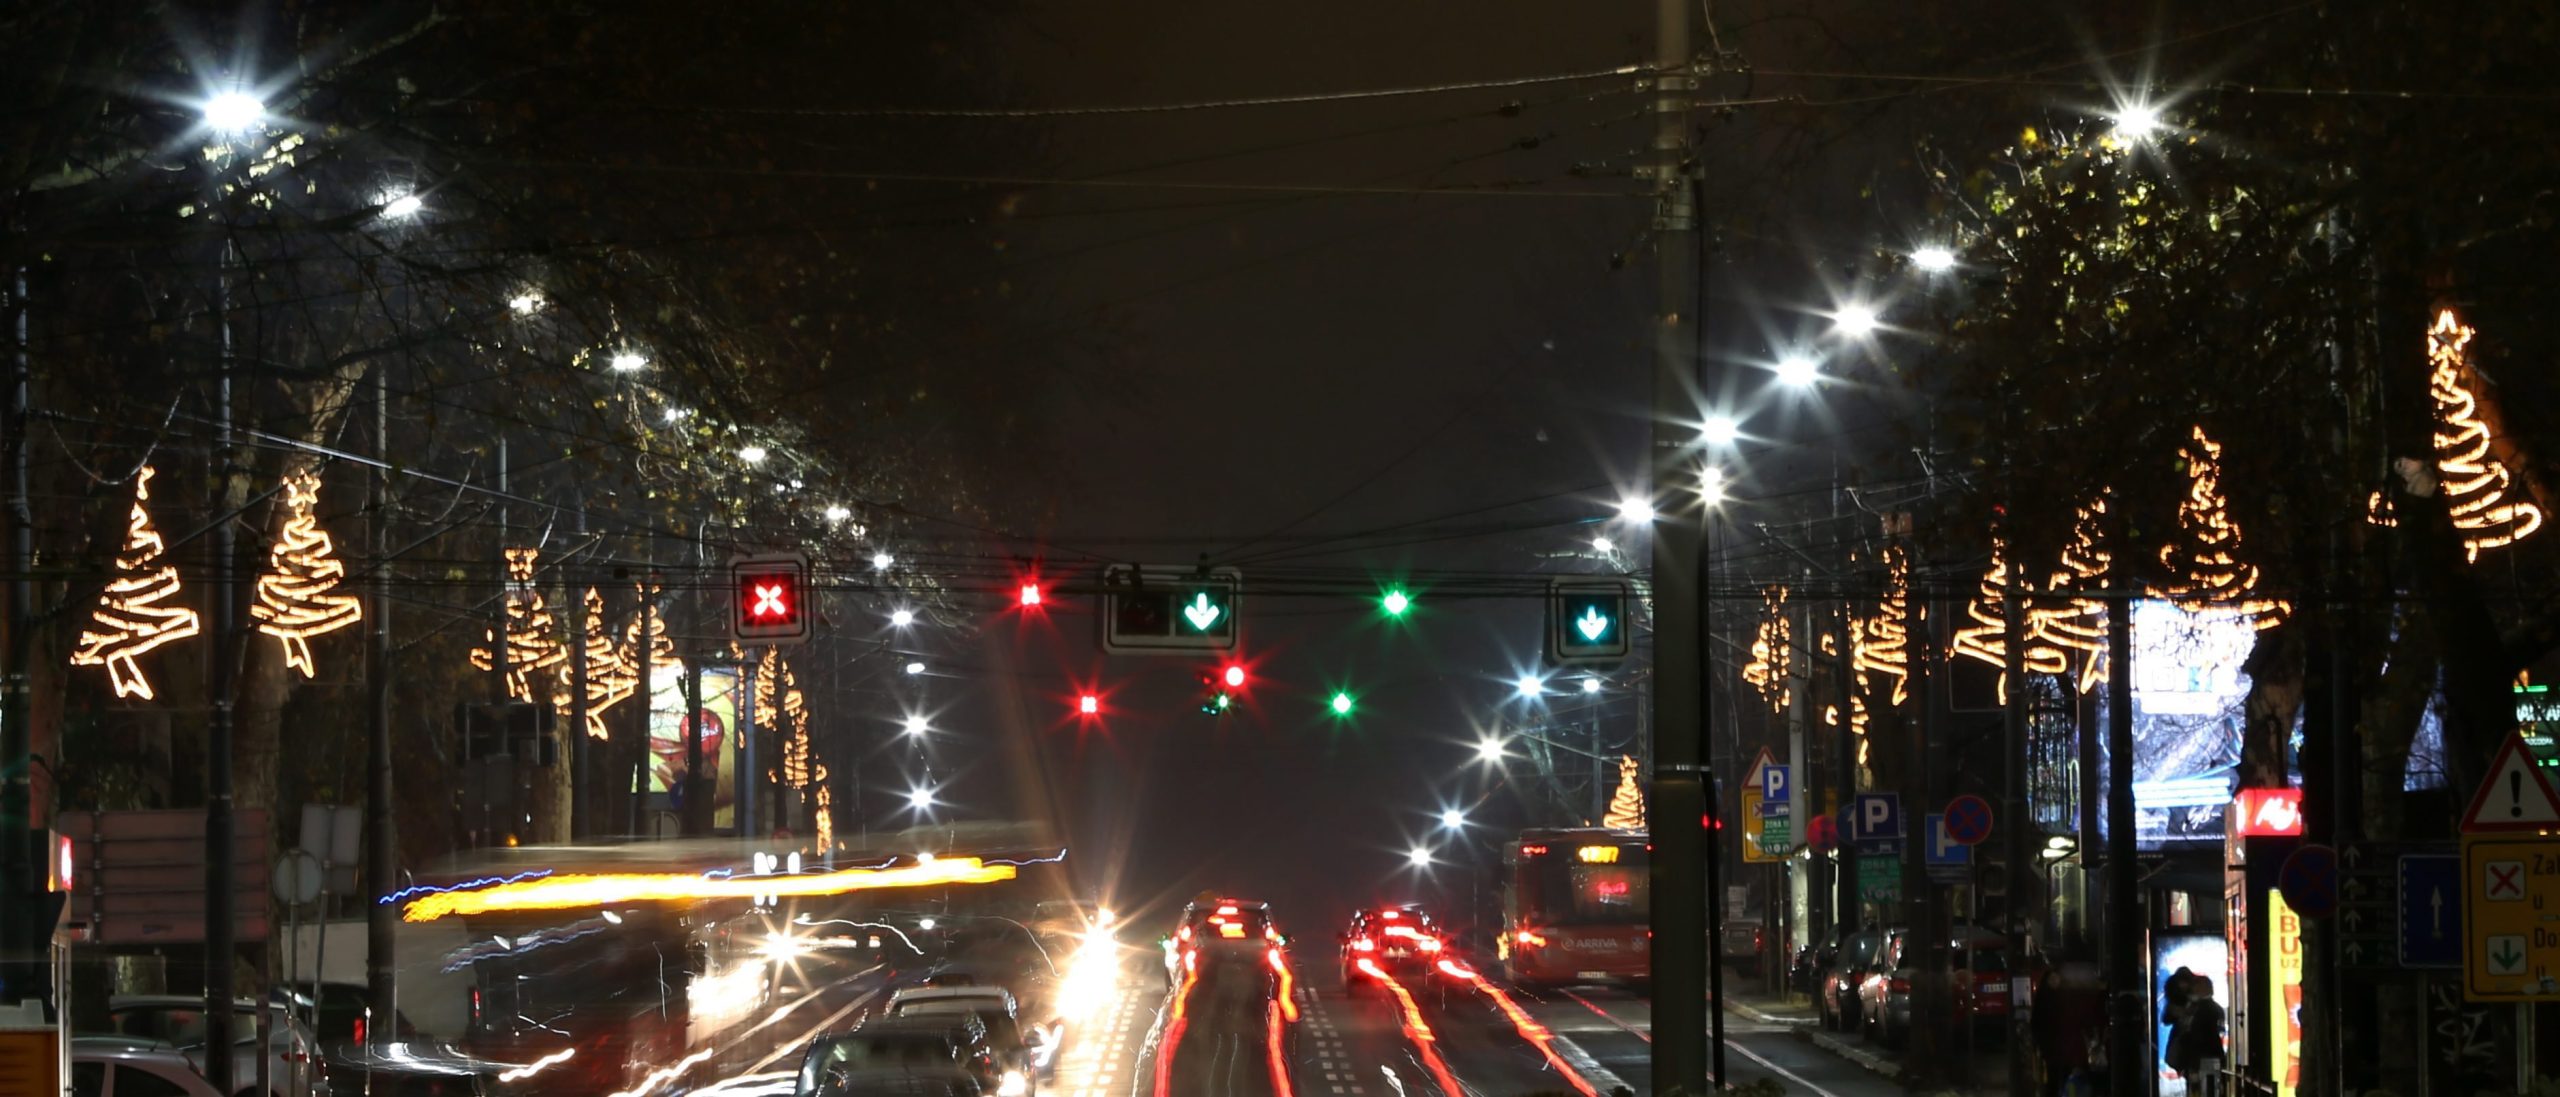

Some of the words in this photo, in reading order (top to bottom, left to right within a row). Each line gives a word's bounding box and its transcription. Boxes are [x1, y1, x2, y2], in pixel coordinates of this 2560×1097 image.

[1768, 769, 1783, 798] P
[1864, 799, 1889, 833] P
[1576, 938, 1618, 949] ARRIVA
[2534, 928, 2560, 948] Do
